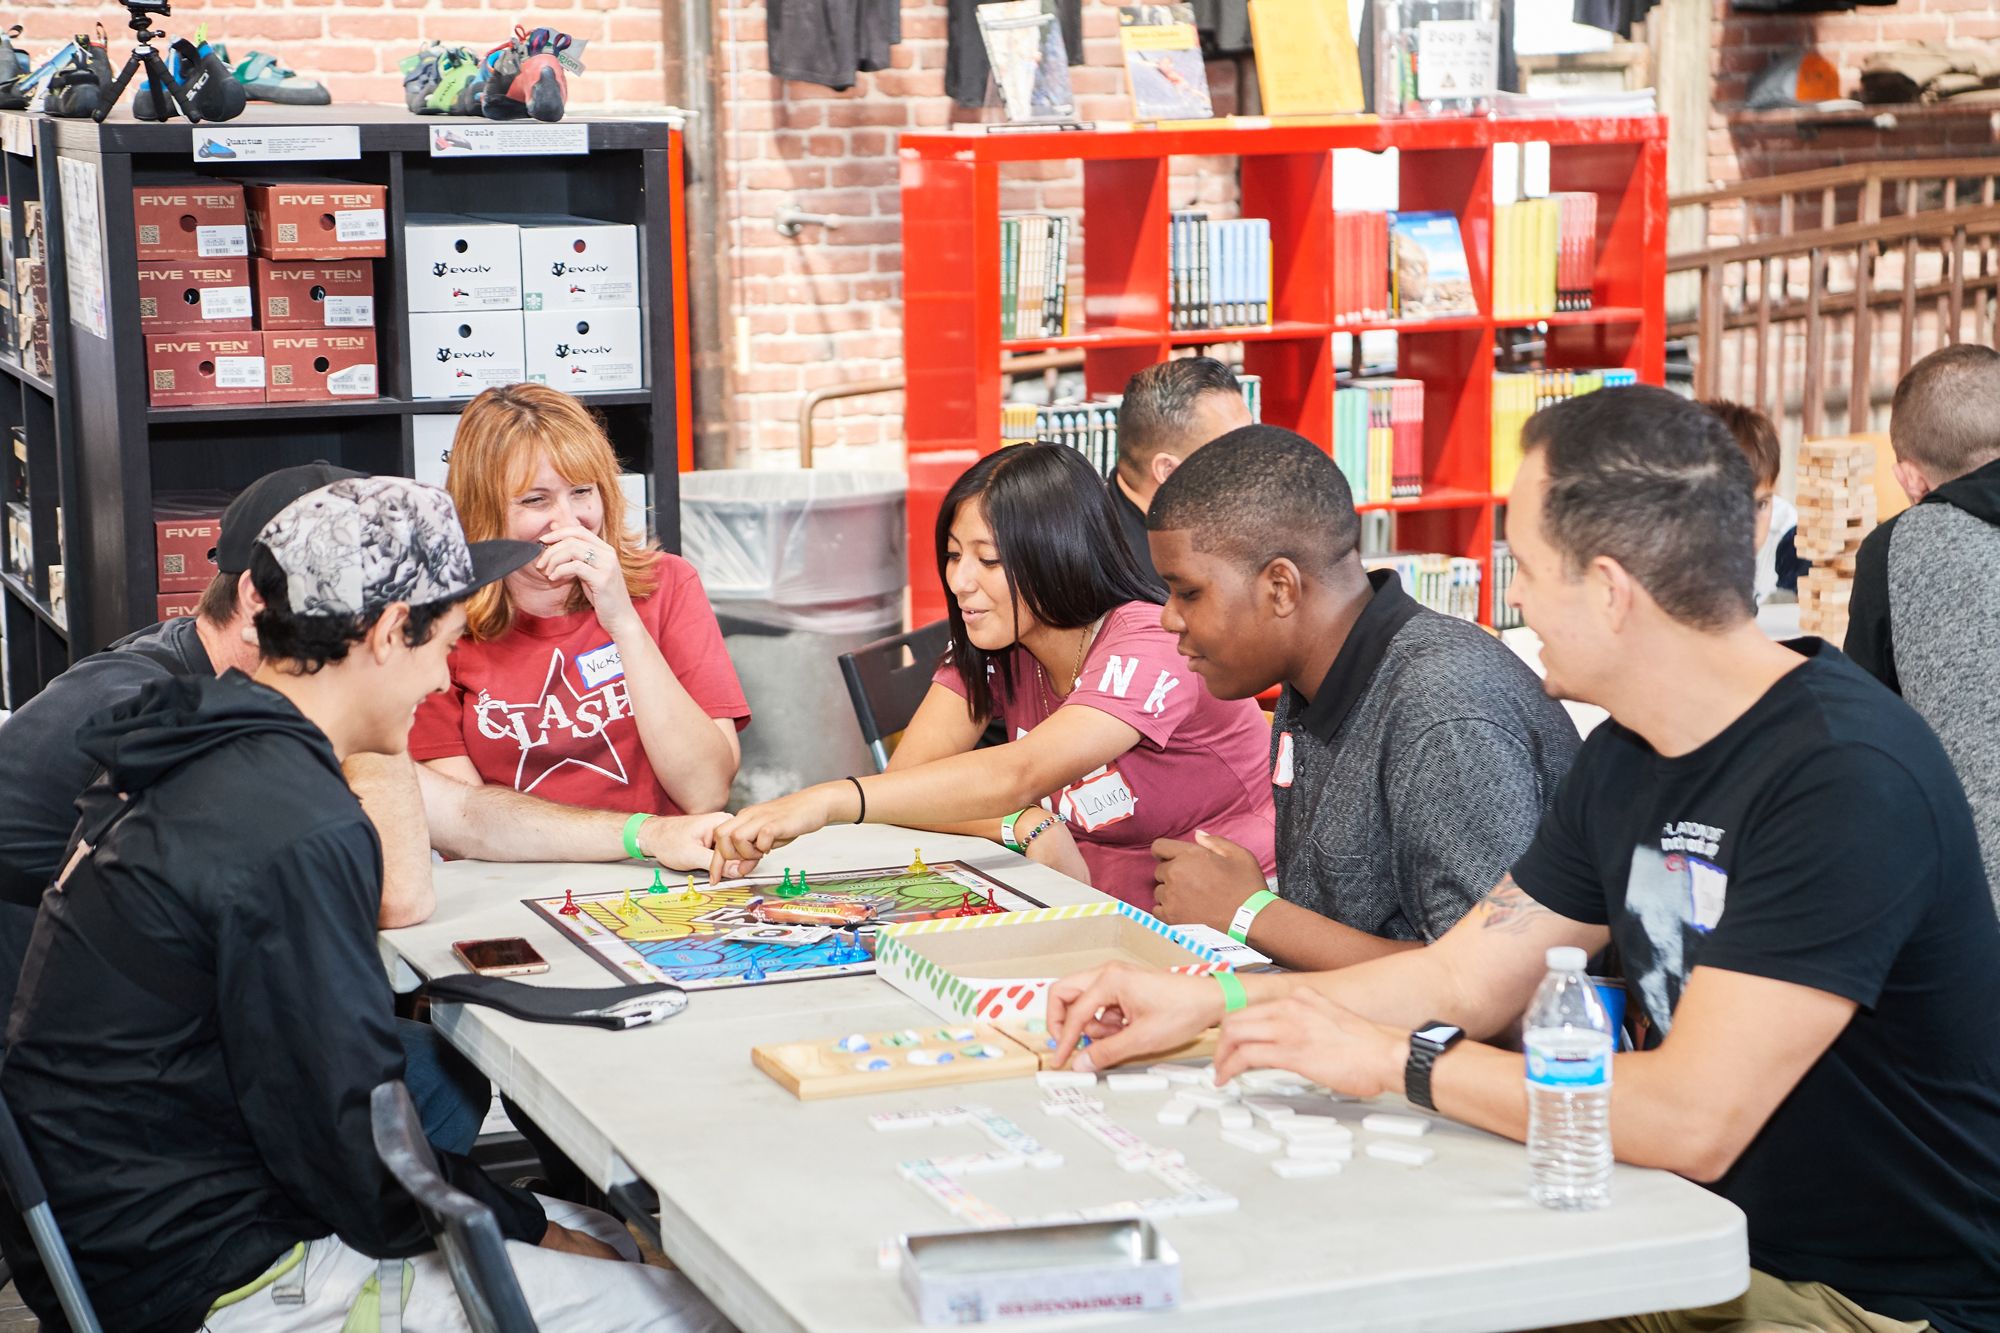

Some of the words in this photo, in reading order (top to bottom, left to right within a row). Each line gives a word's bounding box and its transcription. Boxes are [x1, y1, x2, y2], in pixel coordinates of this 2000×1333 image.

[464, 129, 494, 137] Oracle
[225, 138, 263, 146] Quantum
[140, 195, 187, 206] FIVE
[192, 195, 235, 206] TEN
[279, 194, 325, 205] FIVE
[330, 194, 372, 204] TEN
[449, 264, 492, 274] evolv
[567, 263, 609, 274] evolv
[138, 270, 184, 280] FIVE
[189, 269, 232, 279] TEN
[270, 270, 316, 280] FIVE
[321, 269, 362, 279] TEN
[154, 342, 201, 353] FIVE
[206, 341, 249, 351] TEN
[272, 338, 319, 349] FIVE
[323, 337, 365, 347] TEN
[453, 350, 495, 359] evolv
[571, 345, 613, 355] evolv
[165, 527, 211, 538] FIVE
[165, 606, 198, 617] FIV
[476, 680, 635, 750] CLASH
[1079, 785, 1130, 816] Laura
